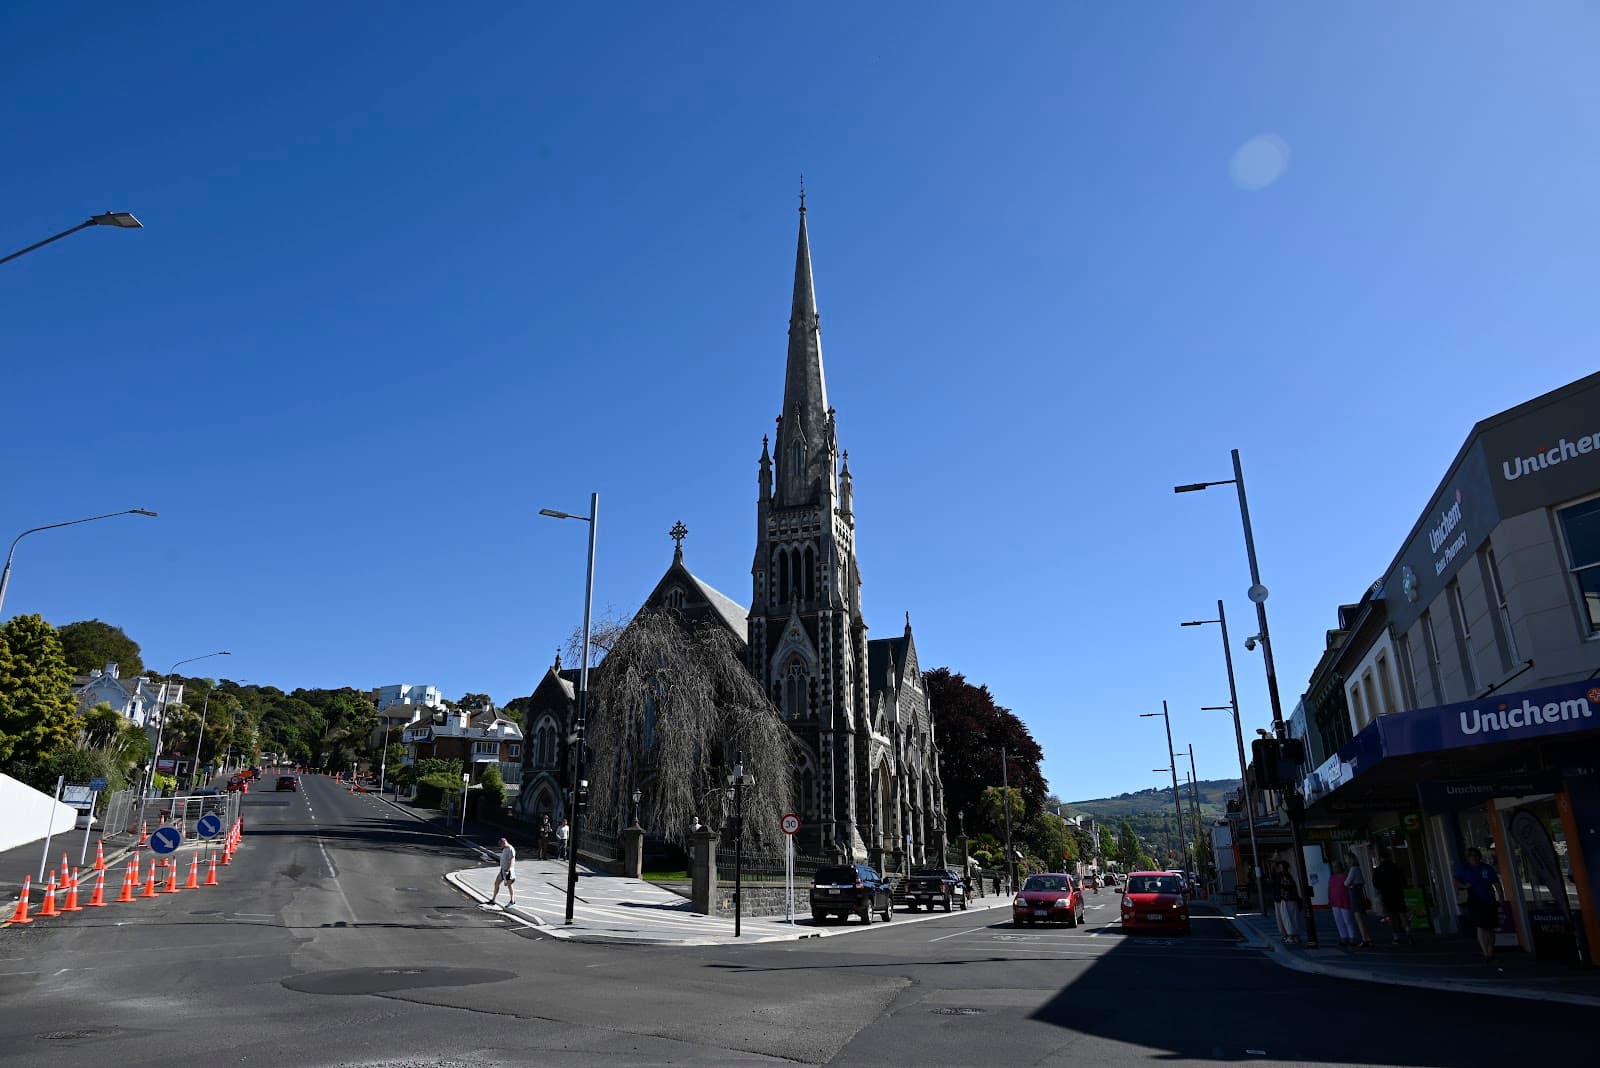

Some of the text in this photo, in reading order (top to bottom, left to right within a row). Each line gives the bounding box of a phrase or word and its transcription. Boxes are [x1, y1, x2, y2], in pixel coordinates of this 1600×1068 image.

[1429, 502, 1462, 554] Unichem
[1445, 530, 1468, 564] Pharmacy
[1460, 697, 1592, 734] Unichem
[785, 820, 796, 829] 30
